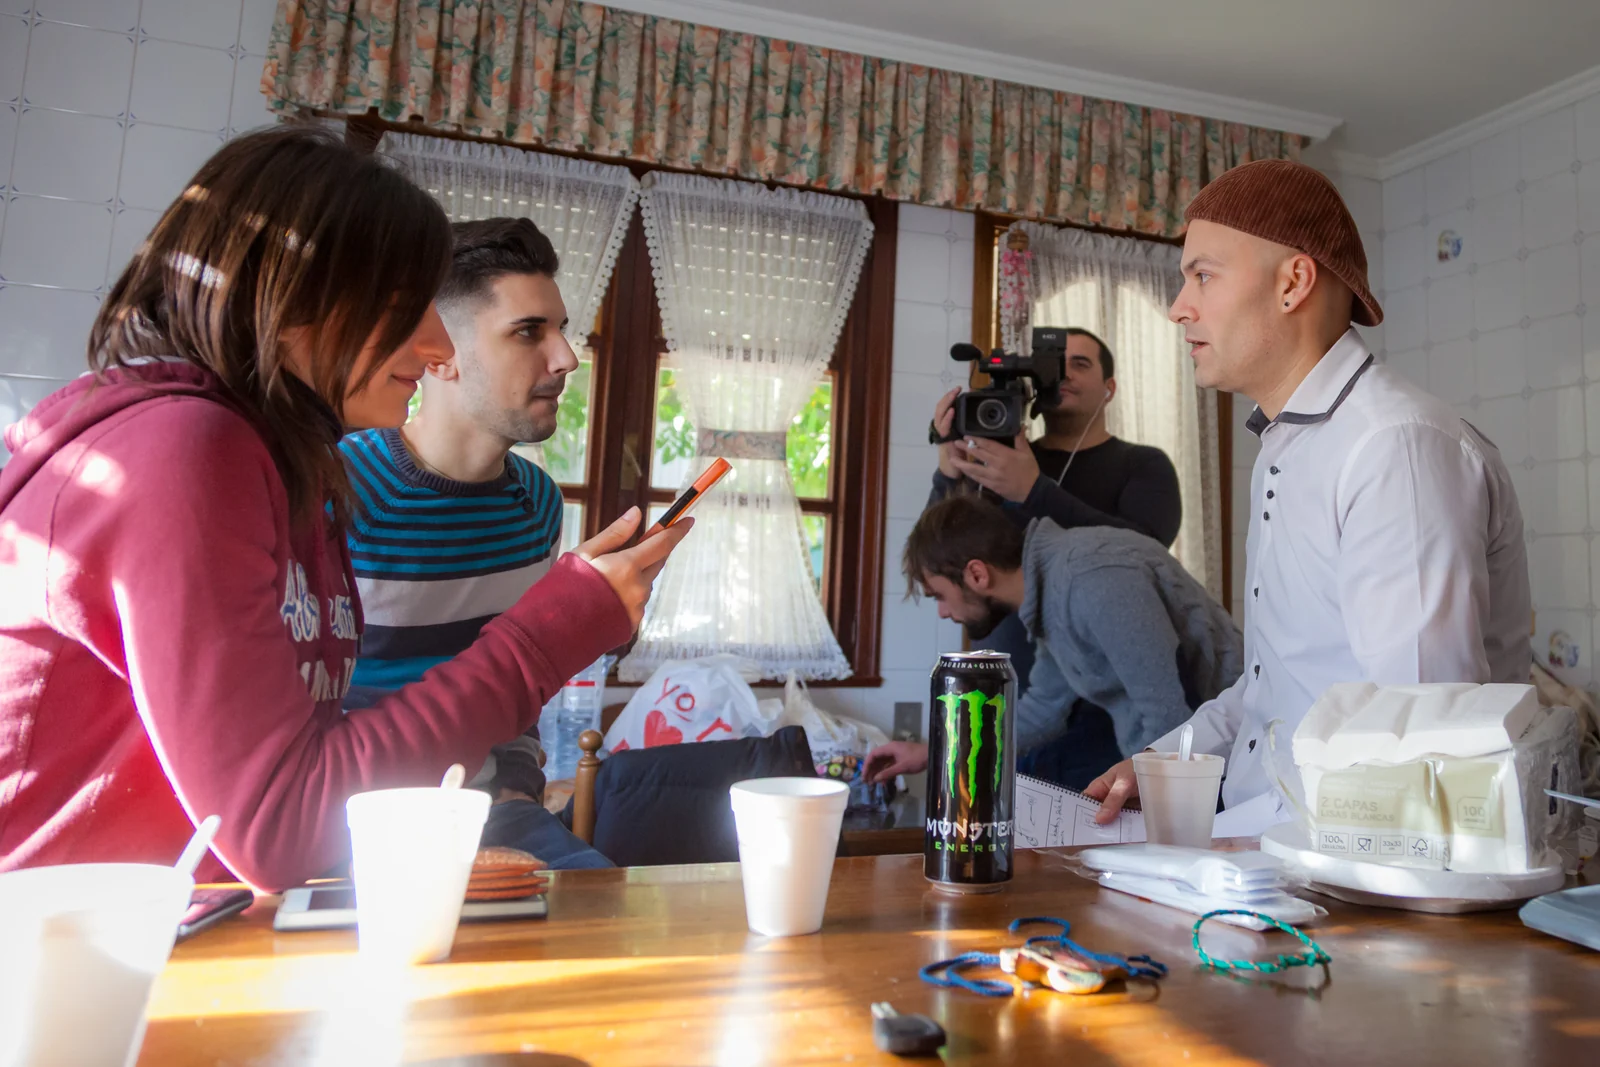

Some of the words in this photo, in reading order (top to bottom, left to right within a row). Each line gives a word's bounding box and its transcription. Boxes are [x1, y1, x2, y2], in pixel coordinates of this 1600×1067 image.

[655, 677, 696, 712] YO
[1333, 798, 1379, 812] CAPAS
[1320, 810, 1347, 819] LISAS
[1350, 812, 1396, 822] BLANCAS
[926, 816, 1014, 842] MONSTER
[934, 841, 1007, 853] ENERGY
